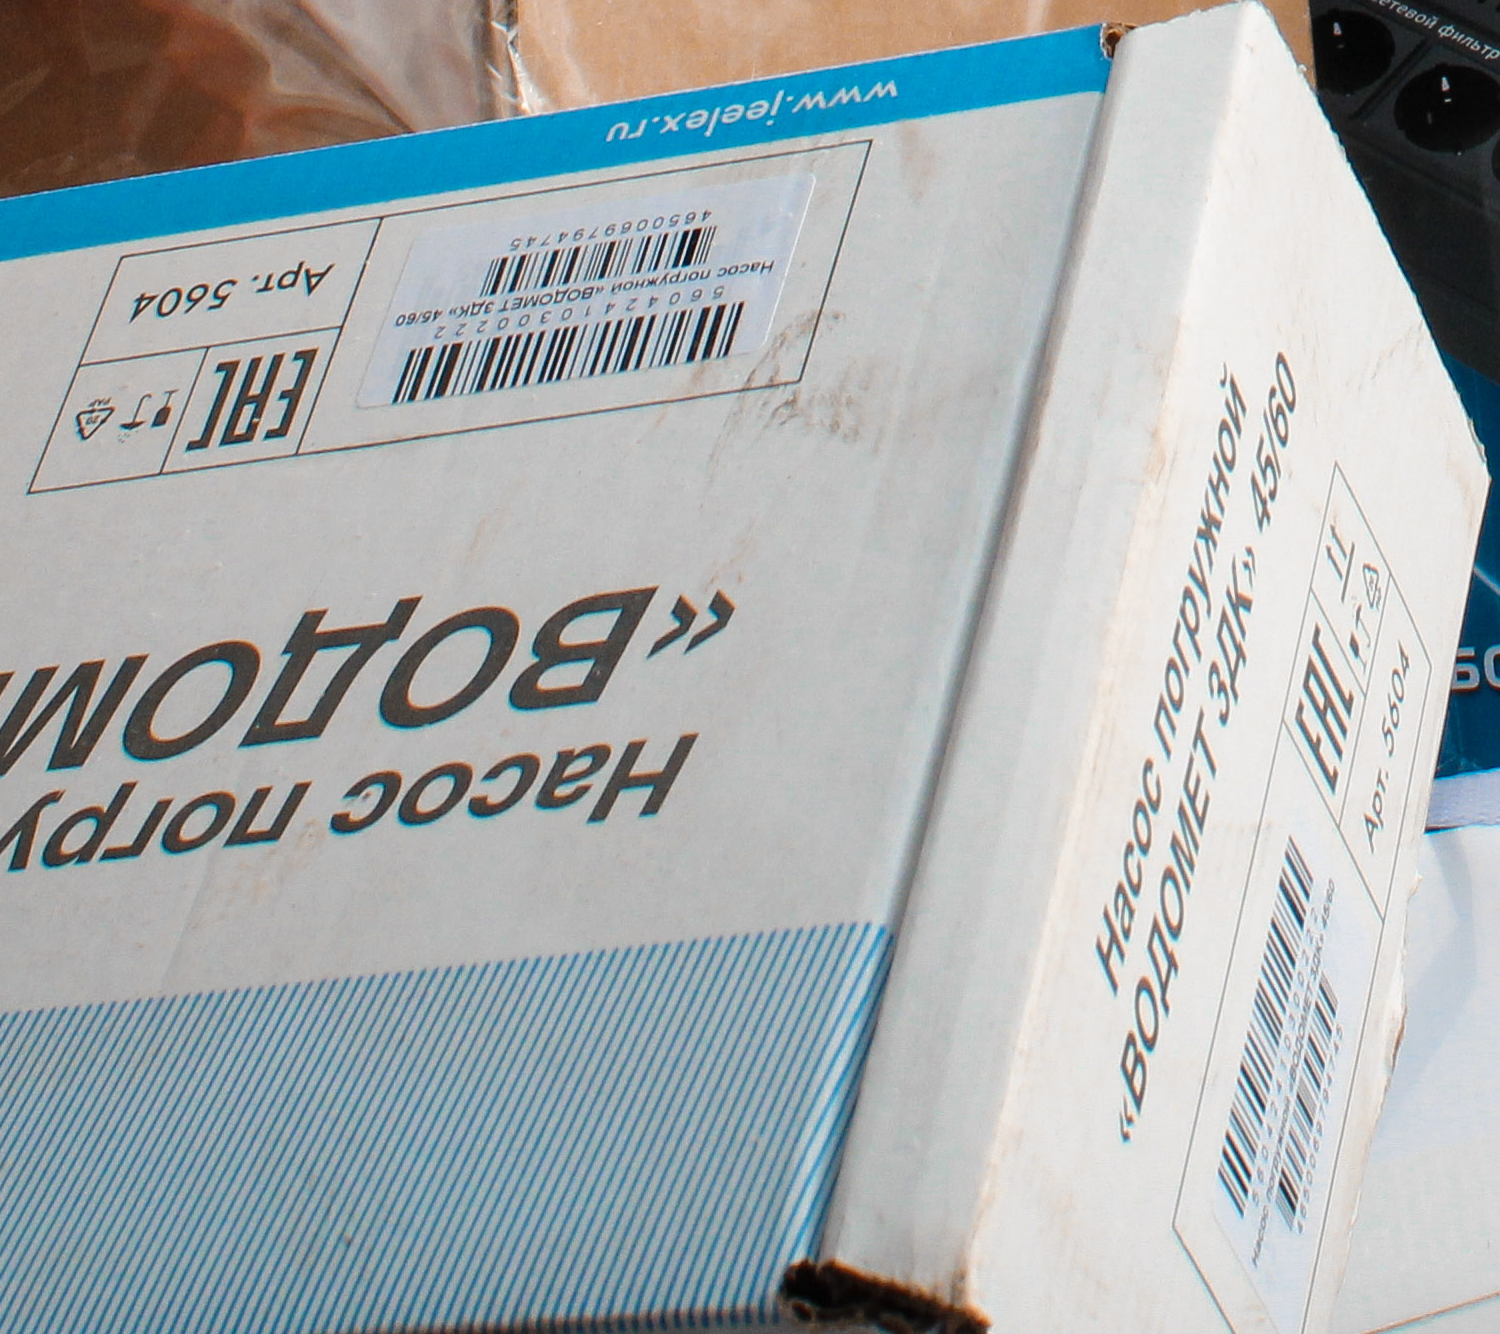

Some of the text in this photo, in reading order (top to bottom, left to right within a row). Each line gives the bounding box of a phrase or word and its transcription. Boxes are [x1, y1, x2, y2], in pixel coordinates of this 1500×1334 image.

[1437, 24, 1500, 61] фильтр
[606, 81, 898, 141] www.jeelex.ru
[509, 209, 713, 250] 4650069794745
[130, 261, 335, 323] Арт. 5604
[612, 261, 775, 294] Насос погружной
[1096, 362, 1247, 997] Насос погружной
[1119, 351, 1296, 1143] «ВОДОМЕТ 45/60
[1361, 638, 1413, 855] Арт. 5604
[331, 732, 698, 838] Насос
